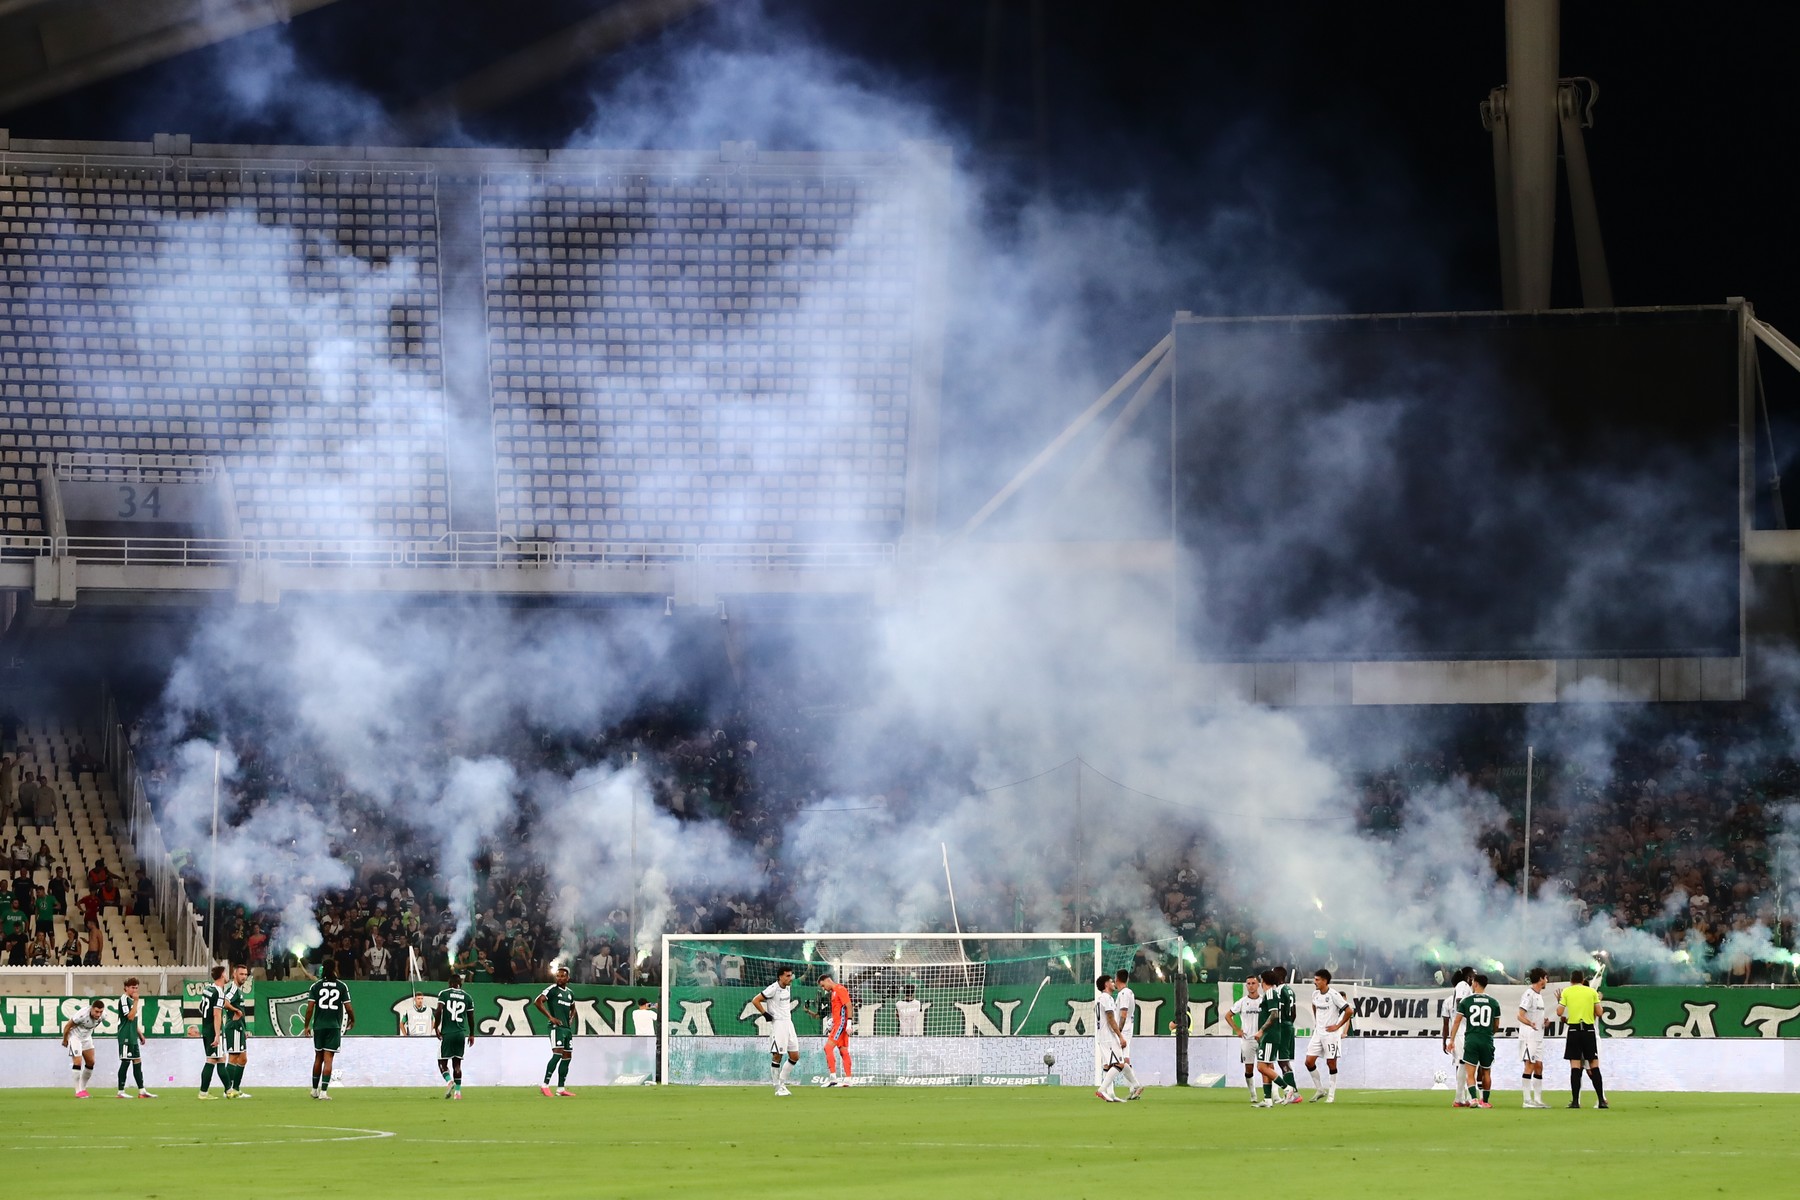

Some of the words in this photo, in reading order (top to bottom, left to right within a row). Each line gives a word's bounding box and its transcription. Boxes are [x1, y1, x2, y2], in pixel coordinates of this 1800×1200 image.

[118, 485, 161, 518] 34
[318, 988, 340, 1010] 22
[1353, 997, 1429, 1018] ΧΡΟΝΙΑ
[0, 997, 185, 1034] TISSA
[446, 1000, 466, 1022] 42
[1469, 1005, 1492, 1027] 20
[1327, 1043, 1336, 1052] 13
[811, 1075, 876, 1086] SUEBET
[896, 1075, 960, 1086] SUPERBET
[982, 1075, 1047, 1086] SUPERBET
